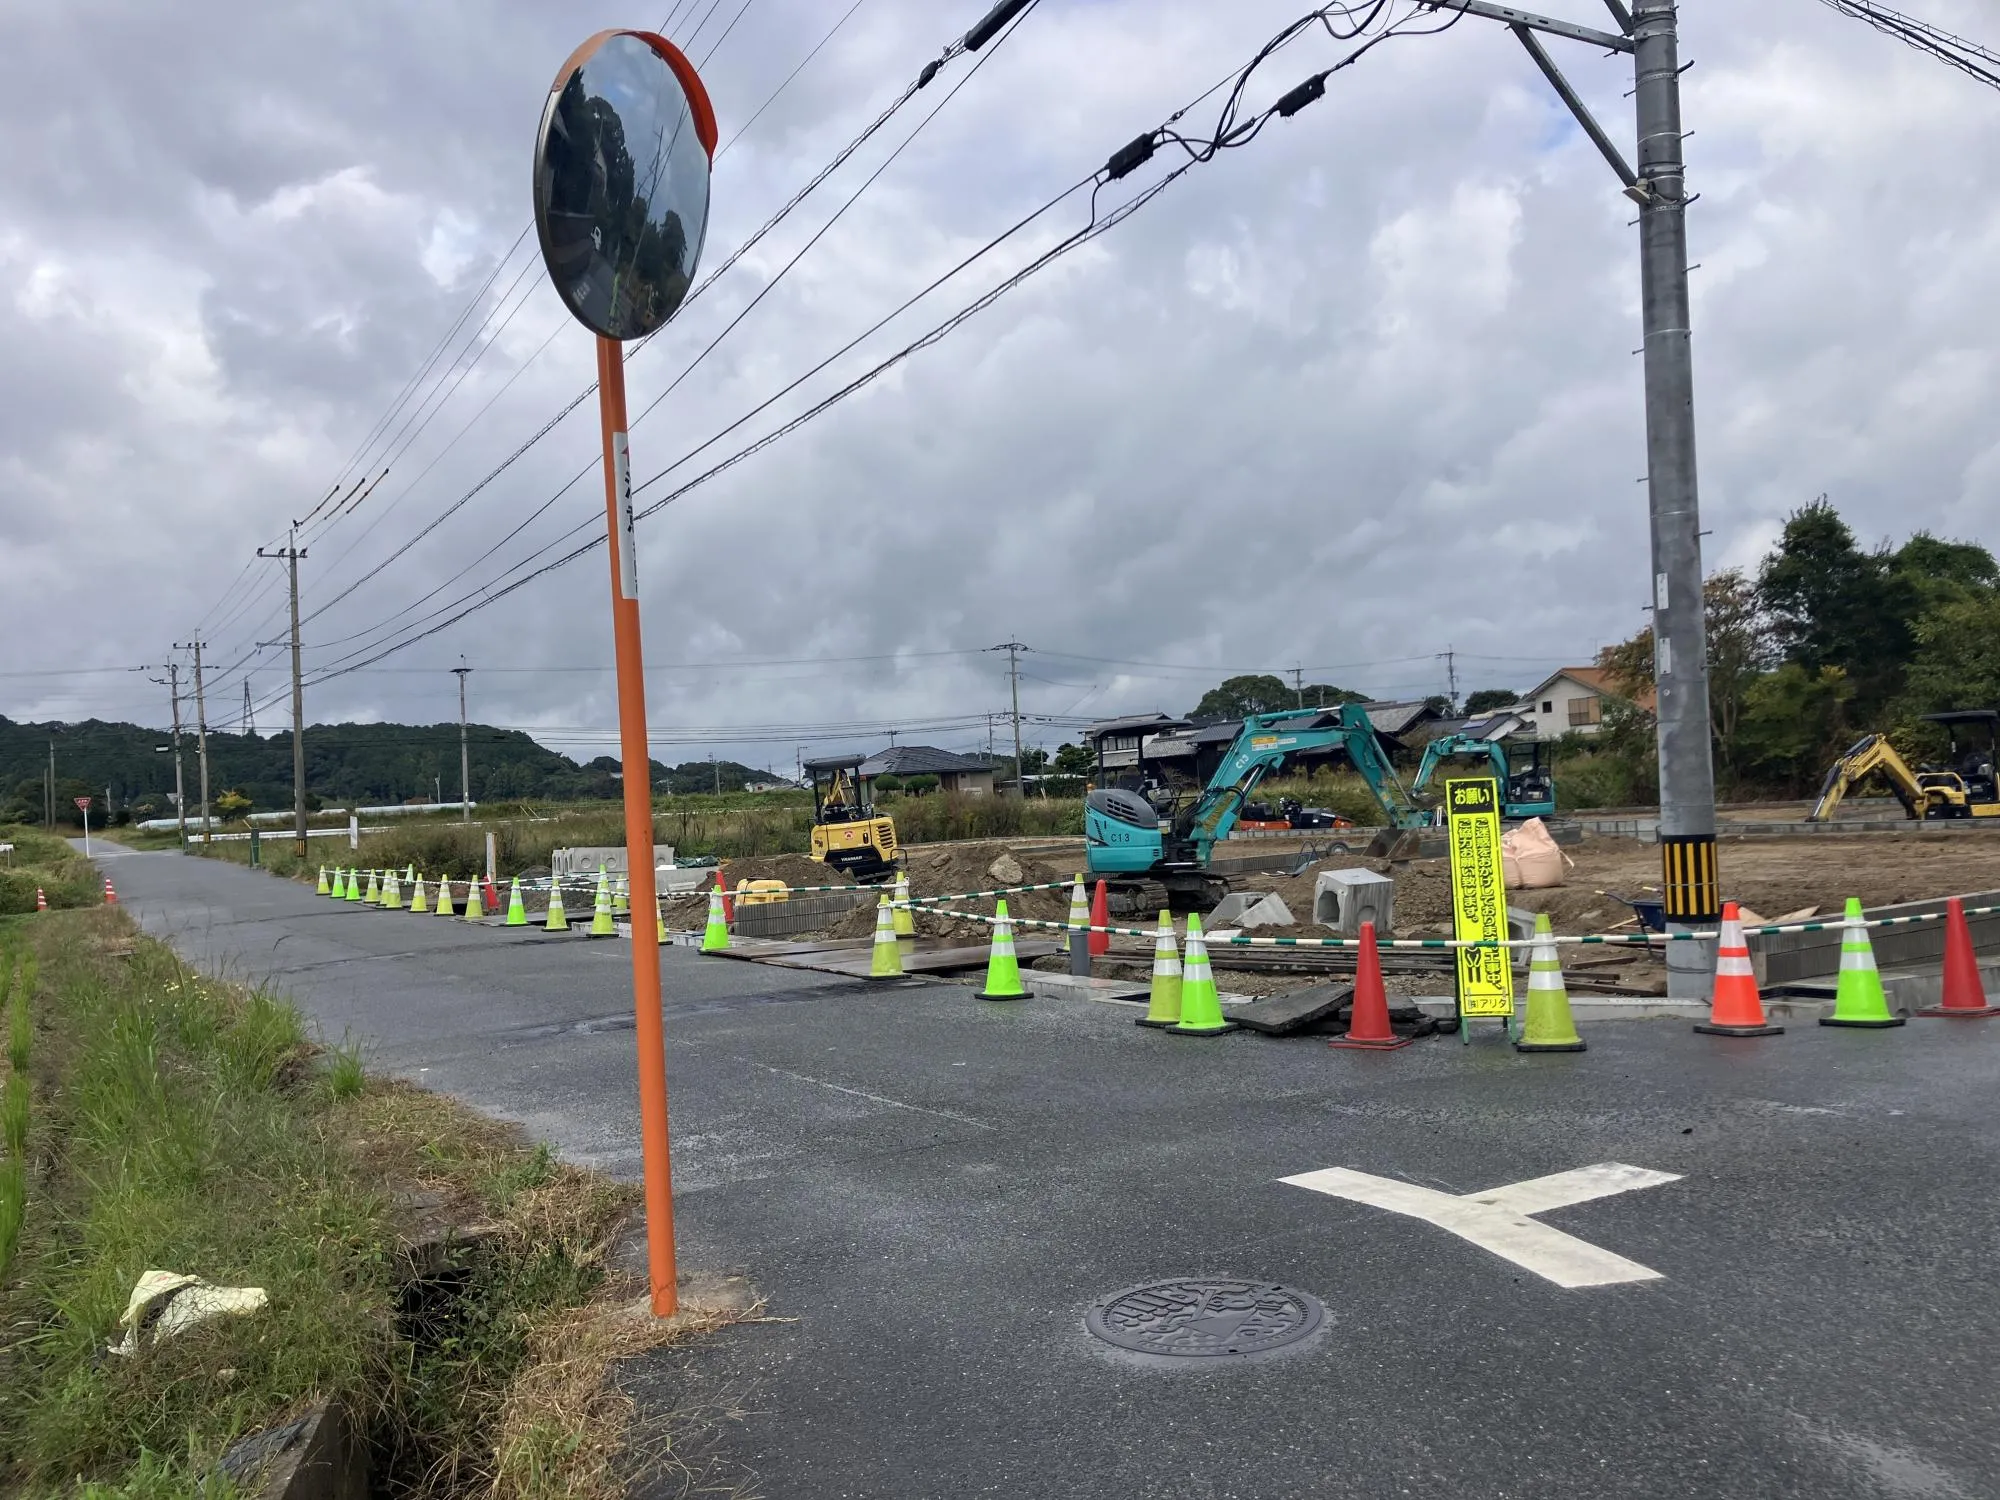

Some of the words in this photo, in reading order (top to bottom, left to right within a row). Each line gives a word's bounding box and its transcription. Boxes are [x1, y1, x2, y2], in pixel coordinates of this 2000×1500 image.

[1454, 787, 1490, 805] お願い
[1111, 833, 1130, 842] C13
